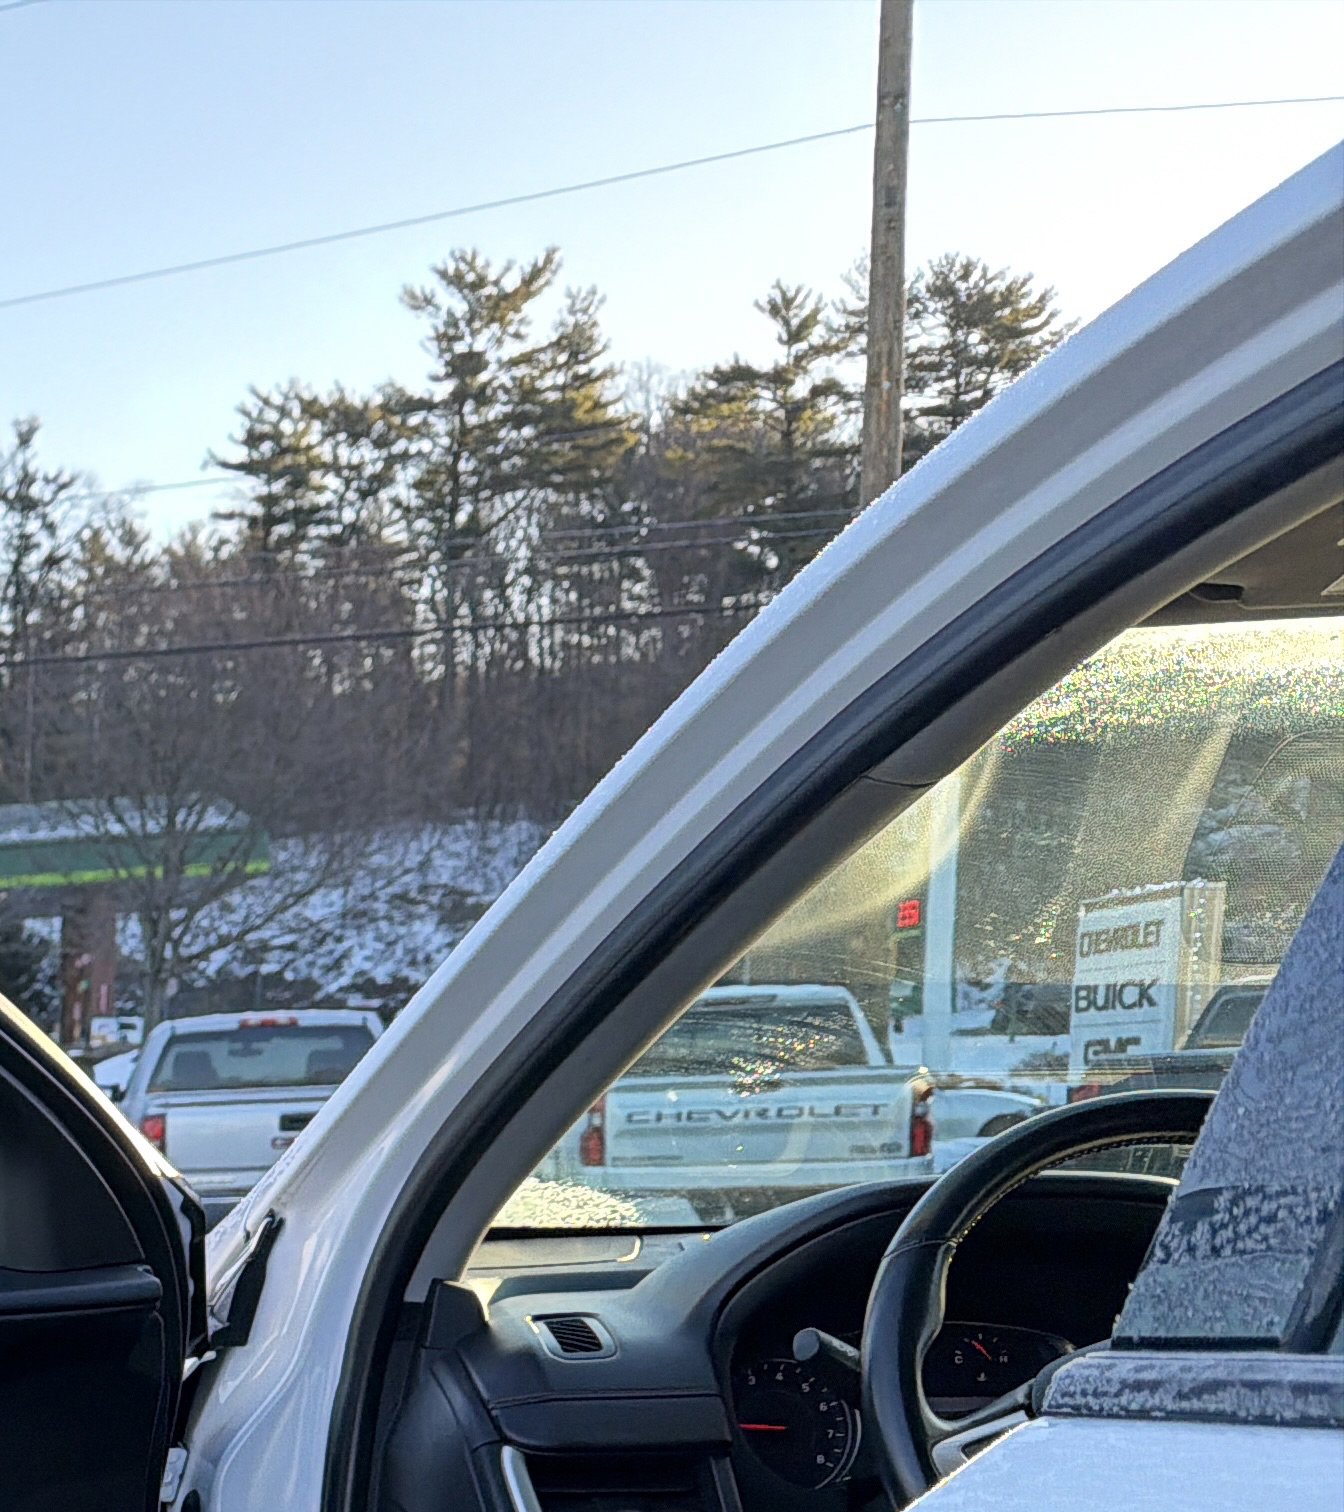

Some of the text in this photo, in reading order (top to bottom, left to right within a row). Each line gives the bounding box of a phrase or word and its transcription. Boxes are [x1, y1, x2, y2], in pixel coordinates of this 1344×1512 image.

[1074, 979, 1159, 1013] BUICK
[626, 1103, 888, 1124] CHEVROLET
[801, 1382, 810, 1392] 5
[827, 1430, 834, 1439] 7
